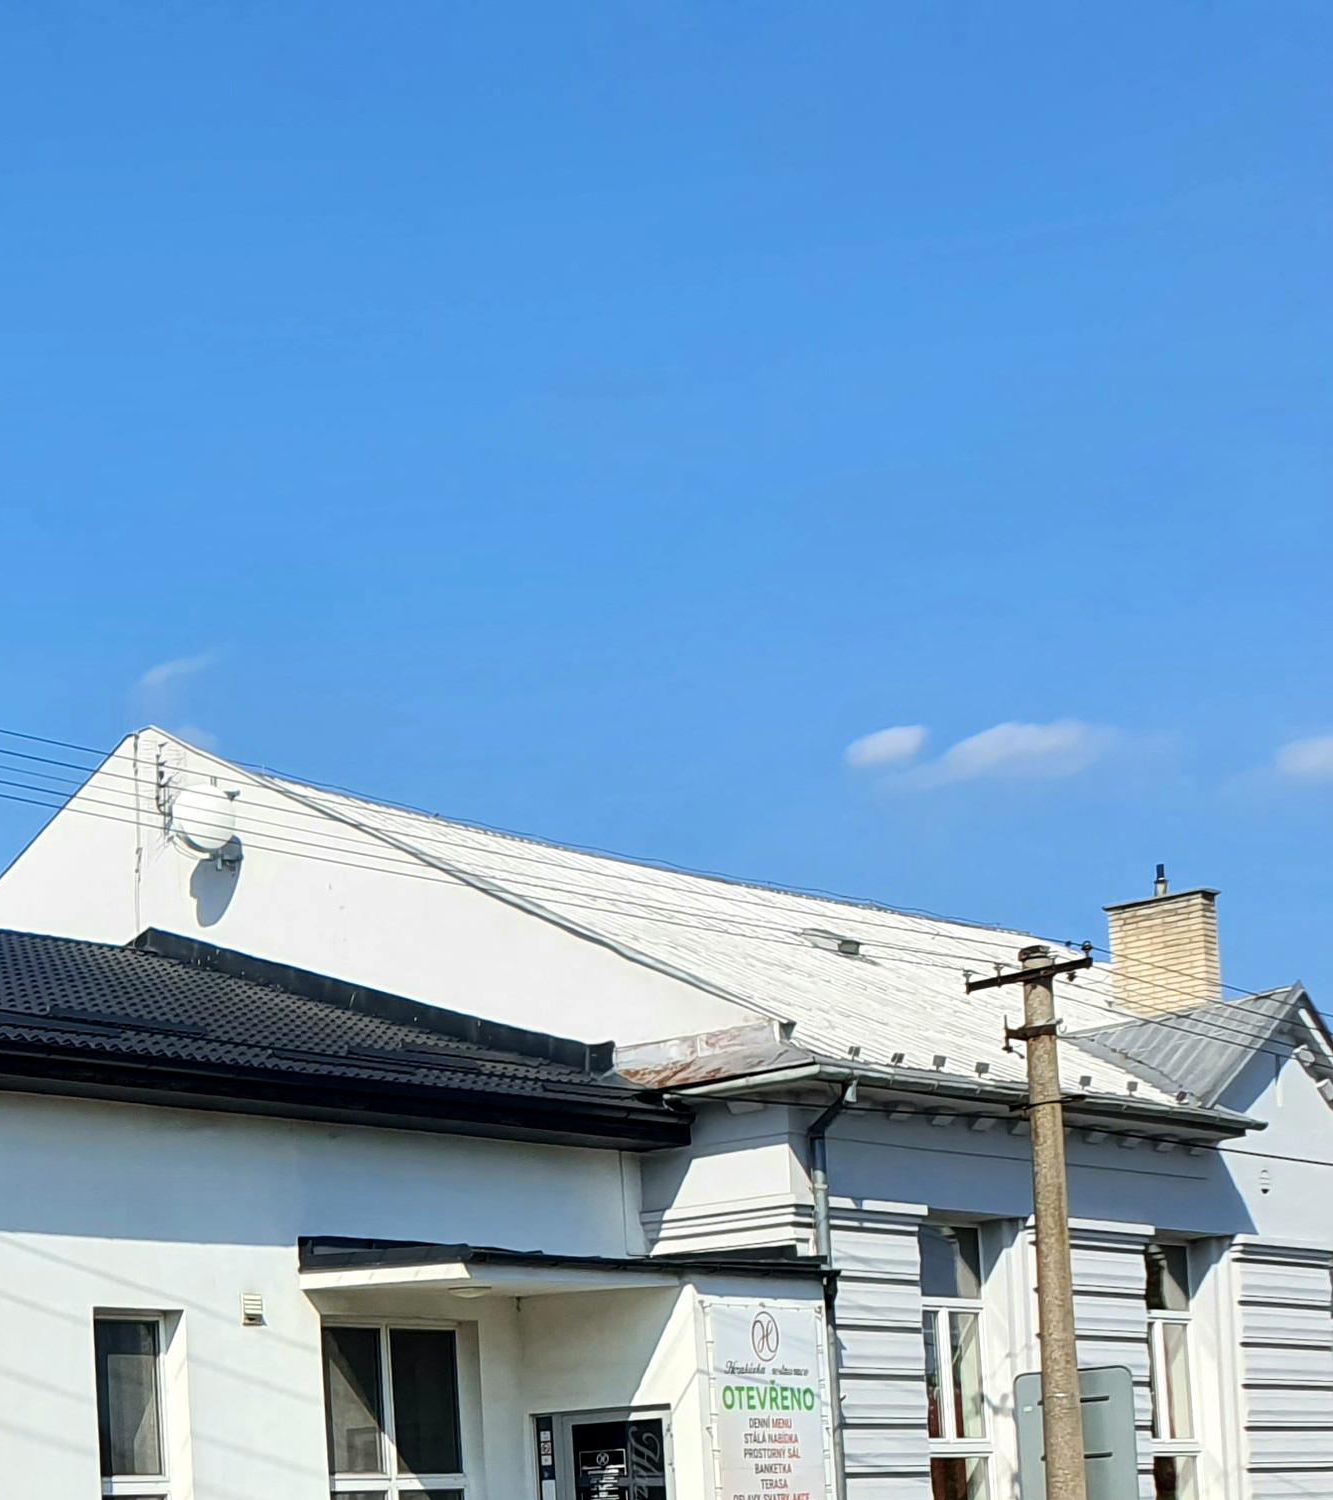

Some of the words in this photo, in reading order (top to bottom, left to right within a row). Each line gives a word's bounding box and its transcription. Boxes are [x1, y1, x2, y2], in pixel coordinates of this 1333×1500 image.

[722, 1380, 815, 1411] OTEVŘENO
[749, 1415, 770, 1429] DENNÍ
[772, 1417, 792, 1429] MENU
[744, 1431, 766, 1444] STÁLÁ
[744, 1446, 786, 1459] PROSTORNÝ
[787, 1446, 801, 1459] SÁL
[755, 1463, 792, 1474] BANKETKA
[761, 1479, 788, 1489] TERASA
